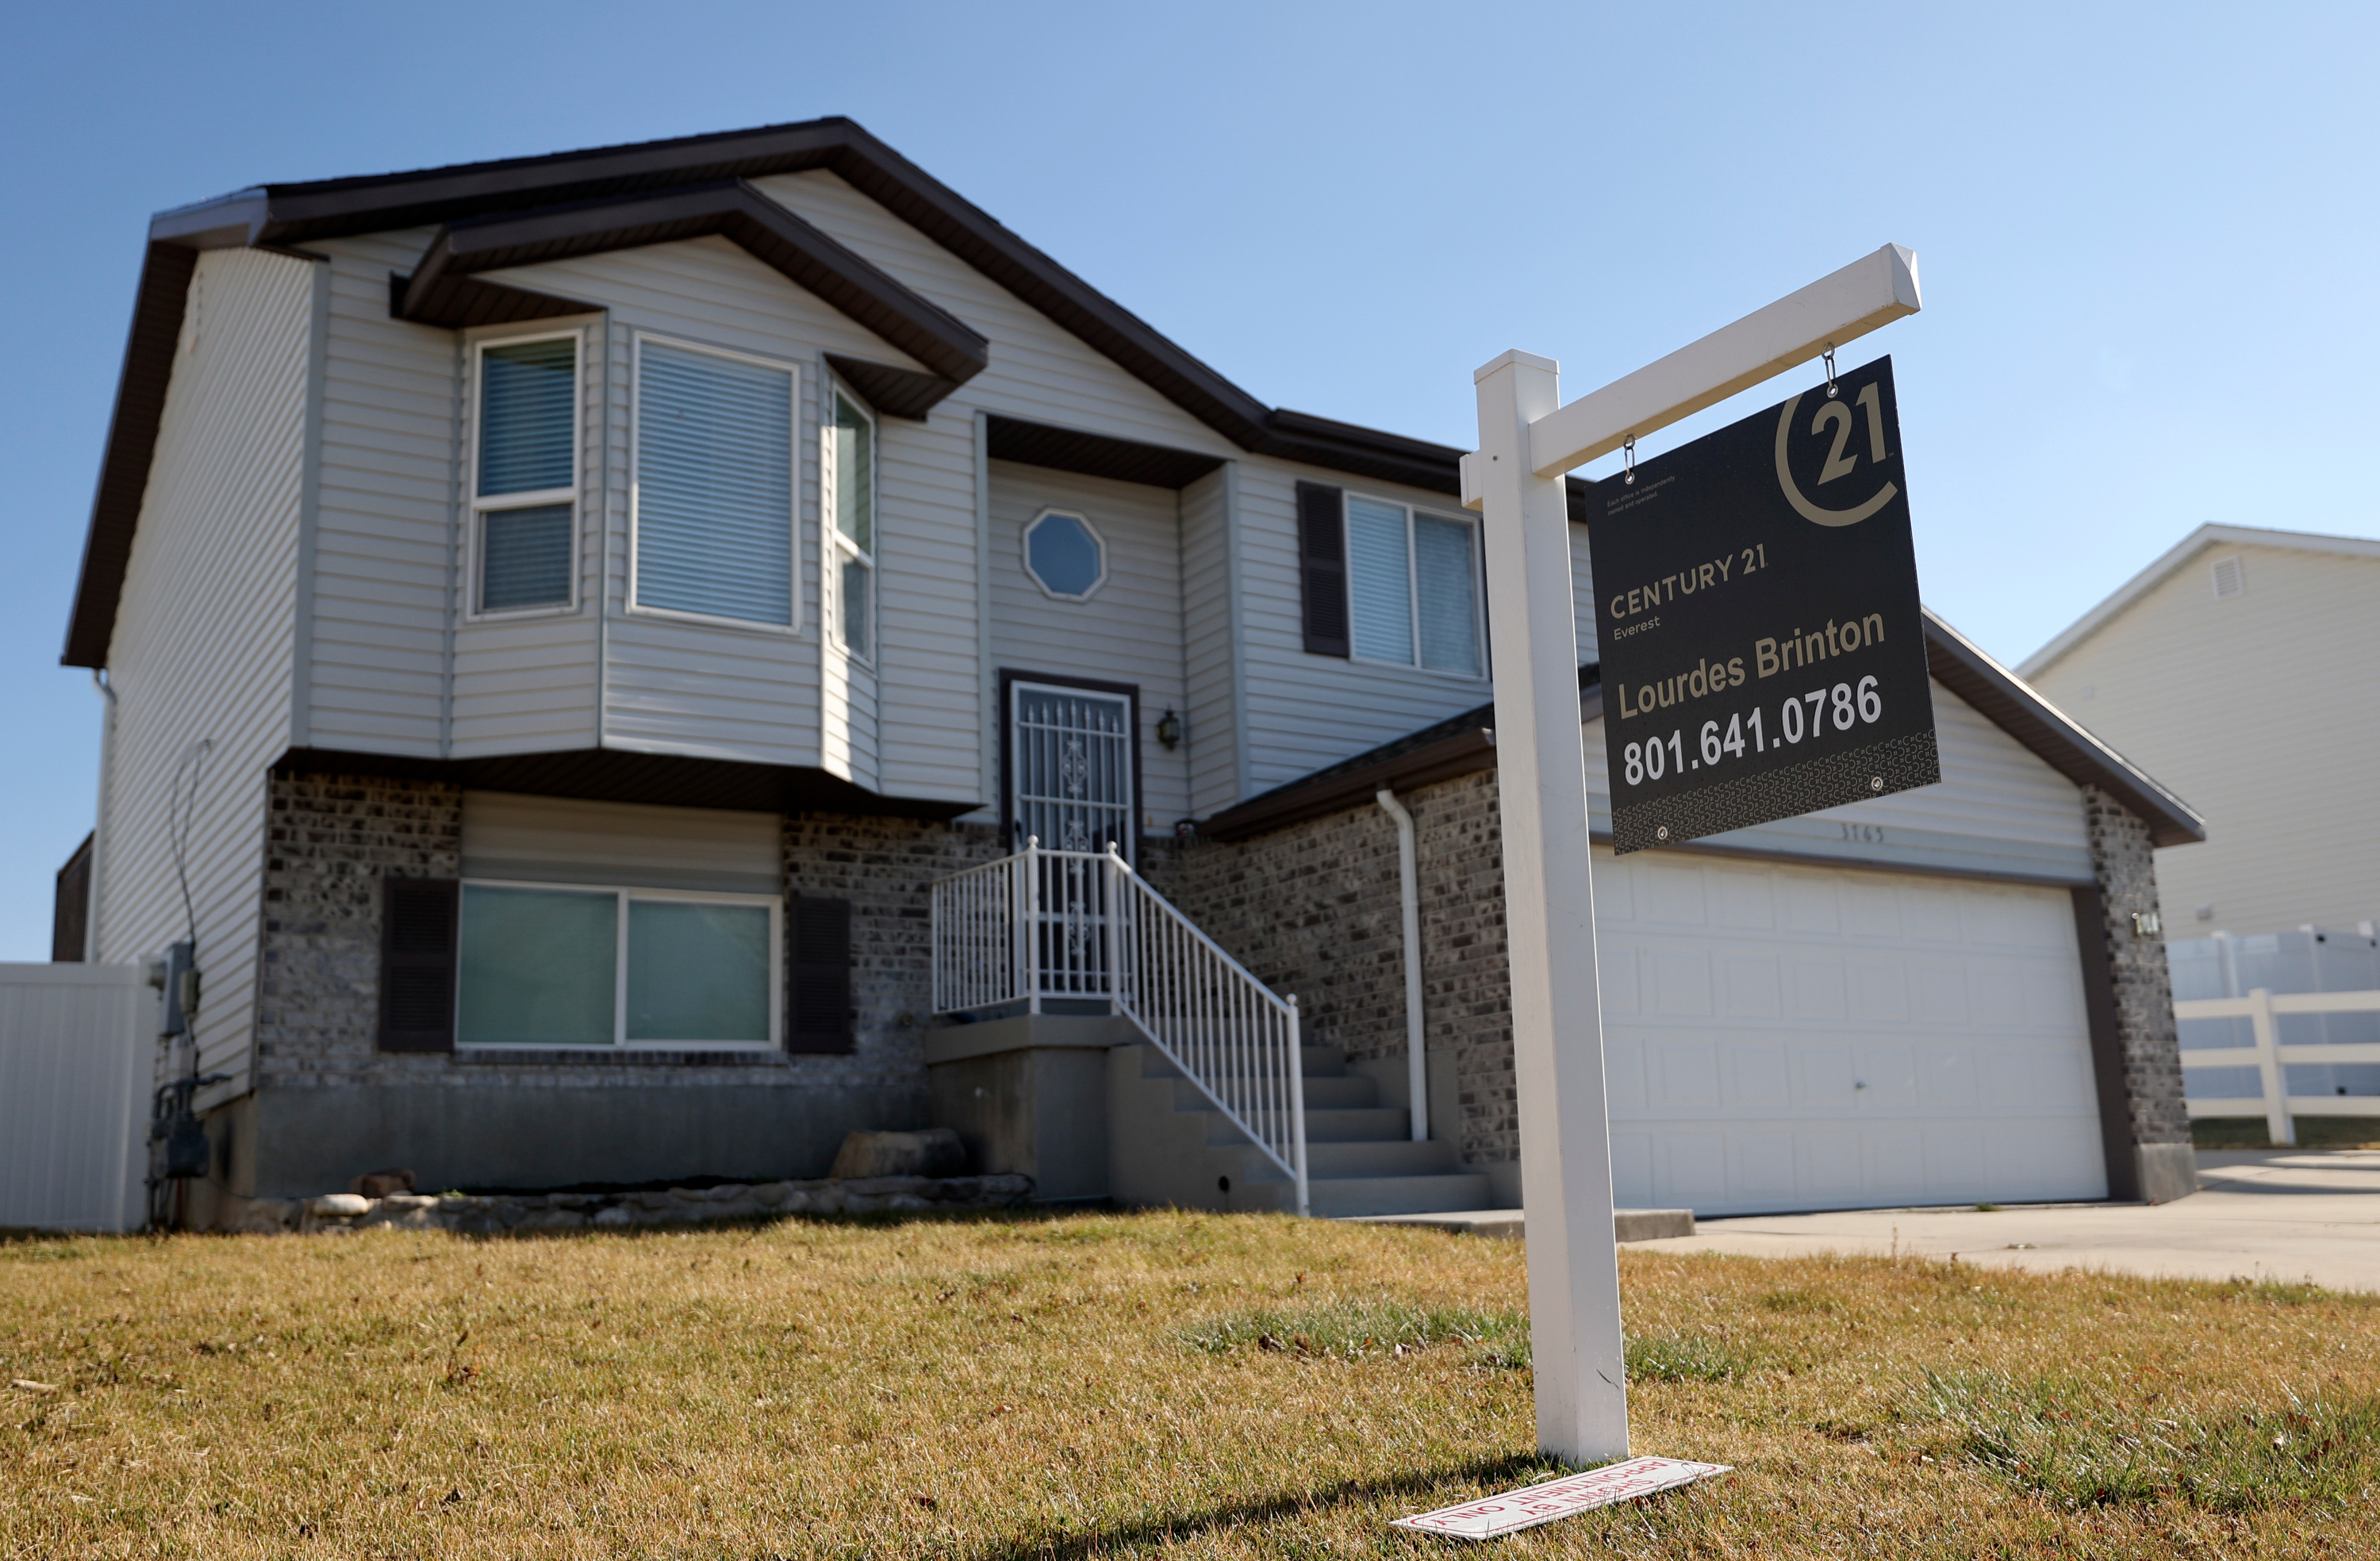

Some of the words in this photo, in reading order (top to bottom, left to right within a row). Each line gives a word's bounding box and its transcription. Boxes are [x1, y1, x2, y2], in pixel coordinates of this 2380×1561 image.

[1606, 497, 1620, 508] Each
[1620, 492, 1634, 501] office
[1640, 475, 1676, 493] independently
[1607, 504, 1624, 516] owned
[1625, 501, 1634, 509] and
[1610, 554, 1733, 619] CENTURY
[1741, 543, 1765, 575] 21
[1614, 616, 1660, 640] Everest
[1618, 657, 1745, 719] Lourdes
[1755, 612, 1885, 679] Brinton
[1624, 675, 1882, 785] 801.641.0786
[1508, 1461, 1668, 1505] APPOINTMENT
[1558, 1479, 1654, 1503] SHOWN
[1430, 1505, 1505, 1525] ONLY
[1518, 1503, 1563, 1515] BY
